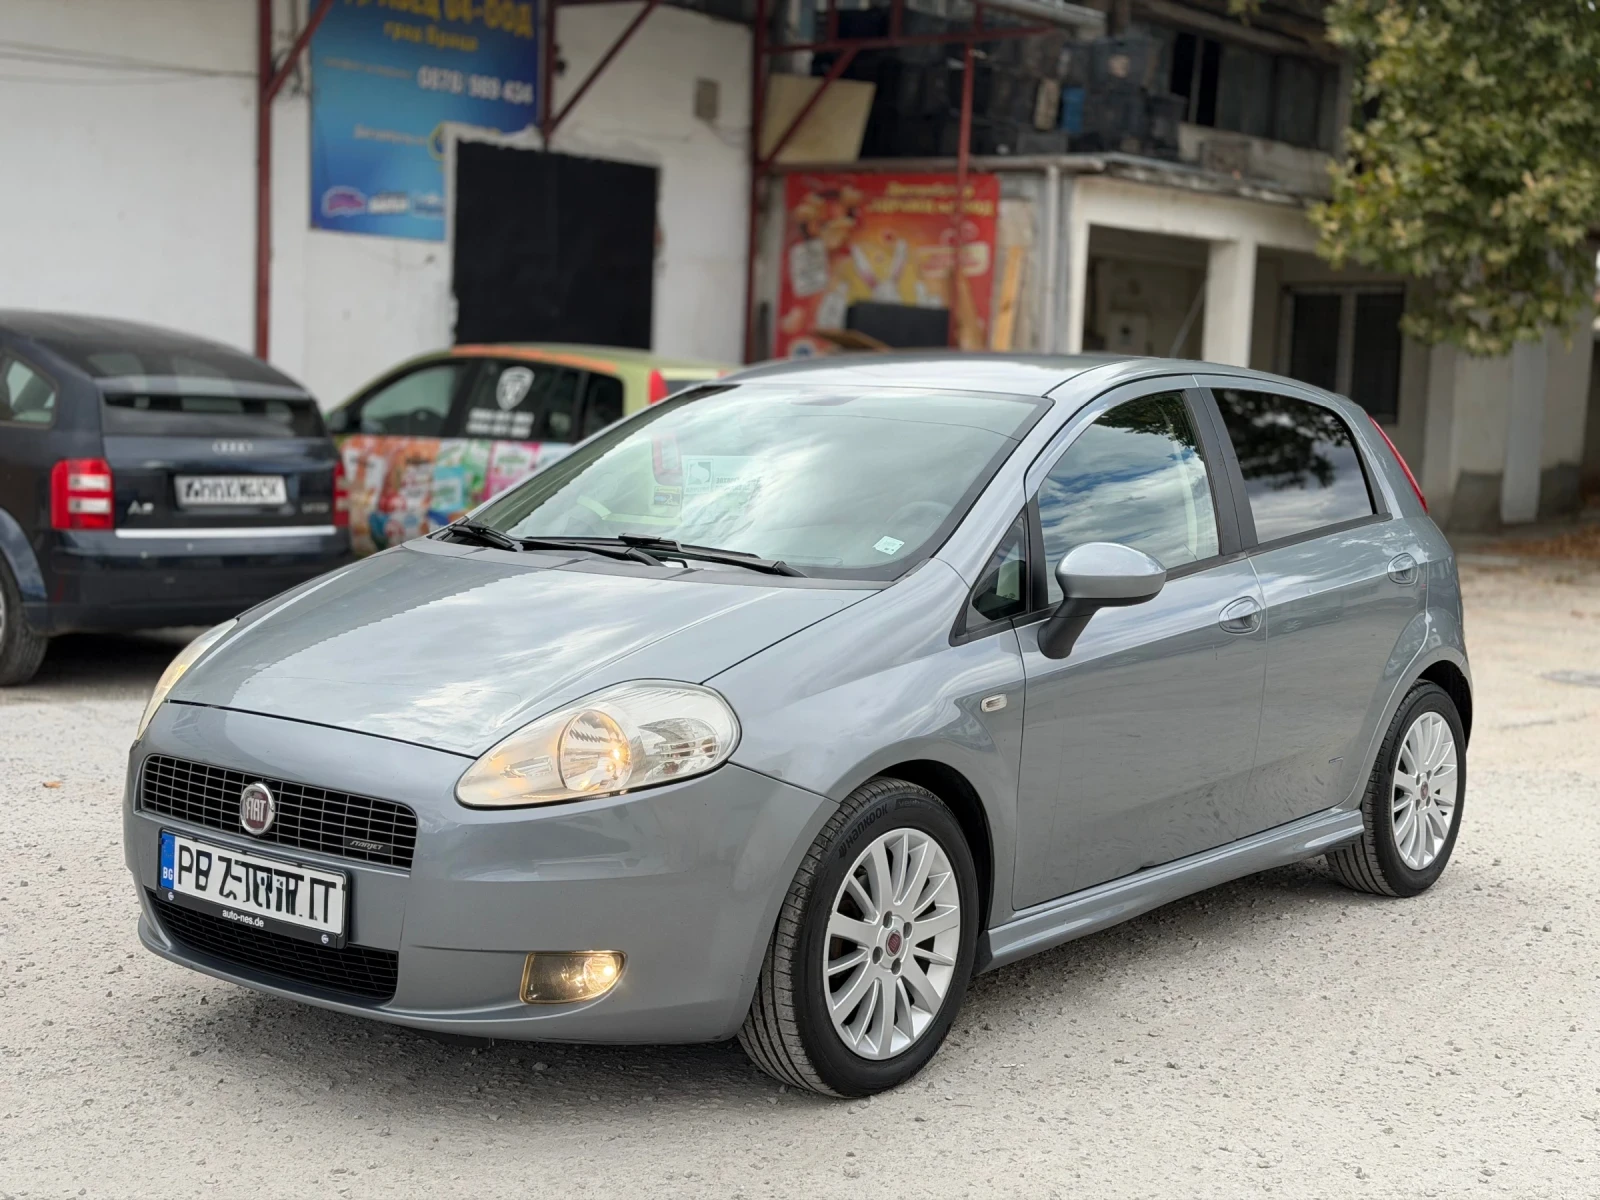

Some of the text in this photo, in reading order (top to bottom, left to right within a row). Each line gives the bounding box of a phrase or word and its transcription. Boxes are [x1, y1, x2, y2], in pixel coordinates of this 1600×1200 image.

[245, 797, 267, 822] FIAT
[162, 866, 174, 881] BG
[222, 908, 265, 928] auto-nes.de
